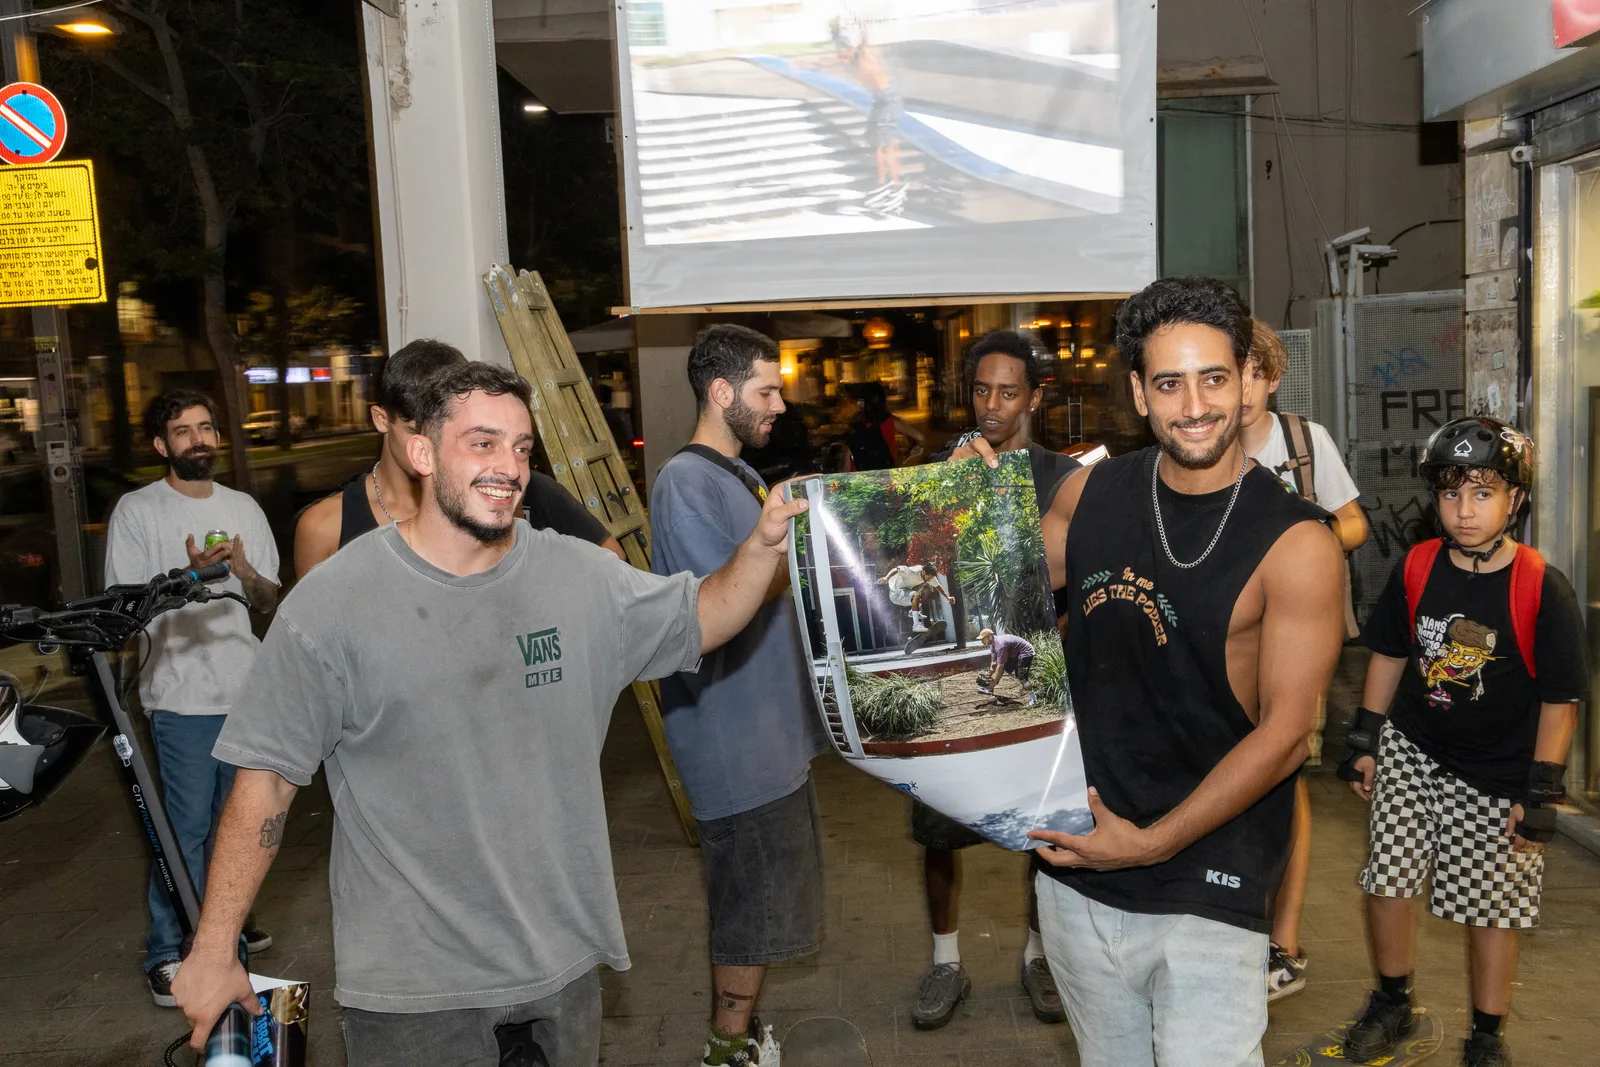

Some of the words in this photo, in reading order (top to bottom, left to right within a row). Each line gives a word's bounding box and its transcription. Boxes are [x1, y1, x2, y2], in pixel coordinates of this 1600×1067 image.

[1122, 566, 1136, 582] In
[1135, 576, 1154, 591] me
[1082, 587, 1108, 617] LIES
[1108, 584, 1137, 601] THE
[1135, 592, 1168, 647] POWER
[1421, 615, 1448, 634] VANS
[516, 626, 562, 667] VANS
[526, 667, 562, 688] MTE
[158, 858, 175, 893] PHOENIX
[1205, 869, 1241, 889] KIS
